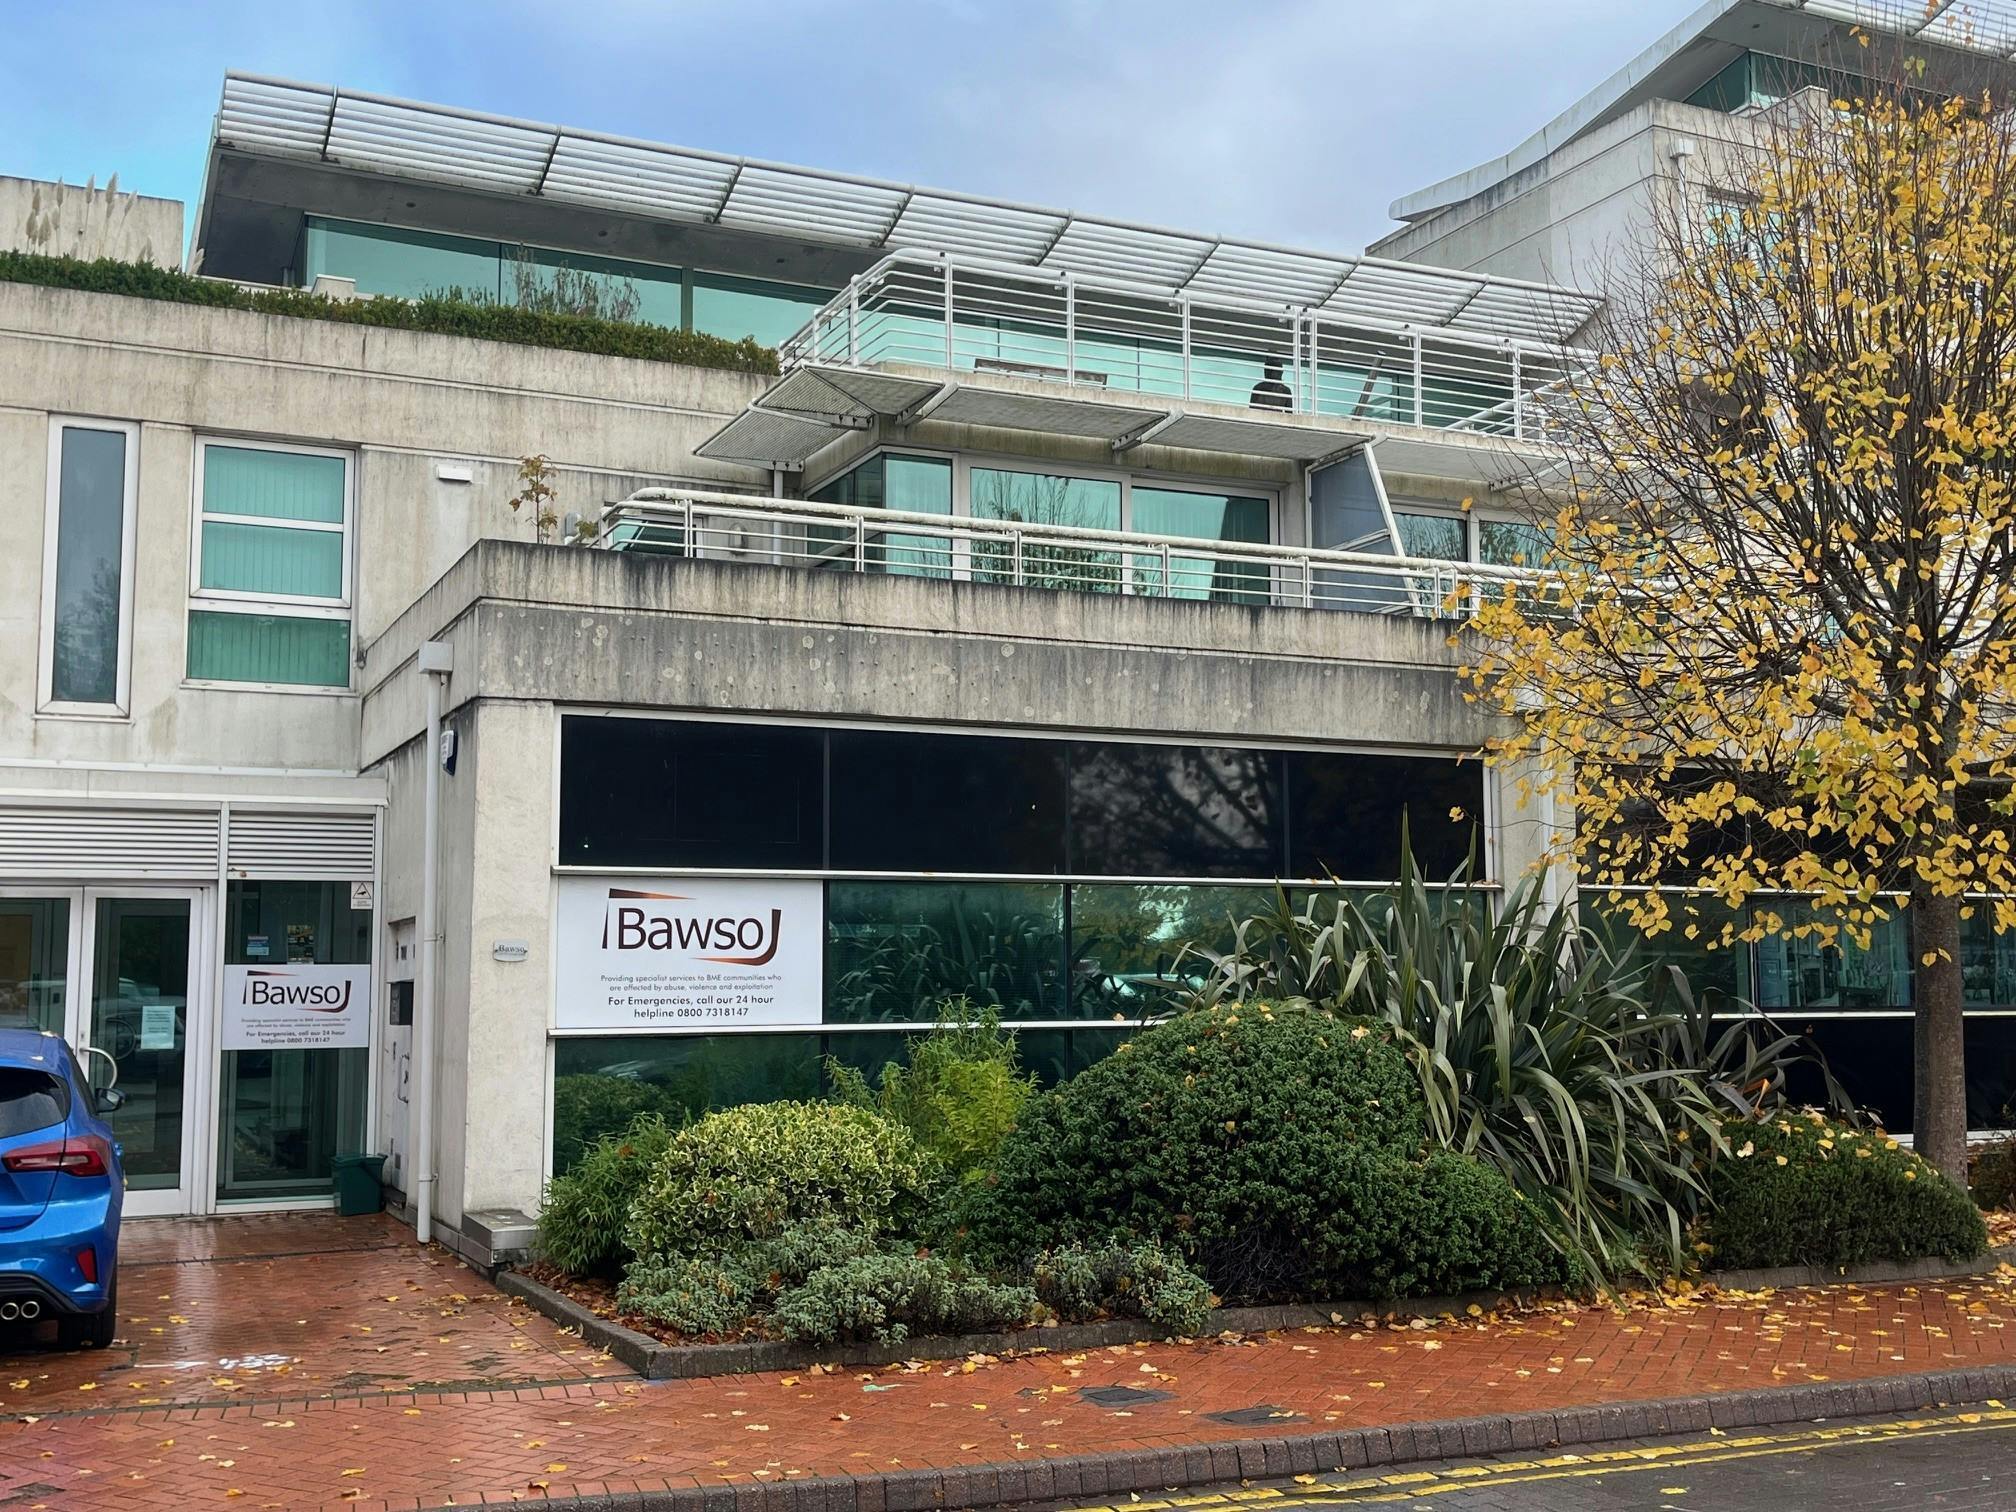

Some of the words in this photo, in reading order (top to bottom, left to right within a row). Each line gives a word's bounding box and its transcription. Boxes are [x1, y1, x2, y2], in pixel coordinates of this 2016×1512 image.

[618, 907, 764, 951] Bawso
[600, 974, 634, 983] Providing
[635, 974, 668, 983] specialist
[669, 974, 696, 982] services
[723, 973, 766, 981] communities
[252, 981, 340, 1005] Bawso
[735, 983, 774, 991] exploitation
[608, 996, 625, 1006] For
[628, 996, 694, 1007] Emergencies,
[696, 995, 713, 1004] call
[736, 995, 748, 1004] 24
[751, 995, 774, 1004] hour
[634, 1008, 674, 1020] helpline
[677, 1008, 702, 1017] 0800
[705, 1007, 749, 1017] 7318147
